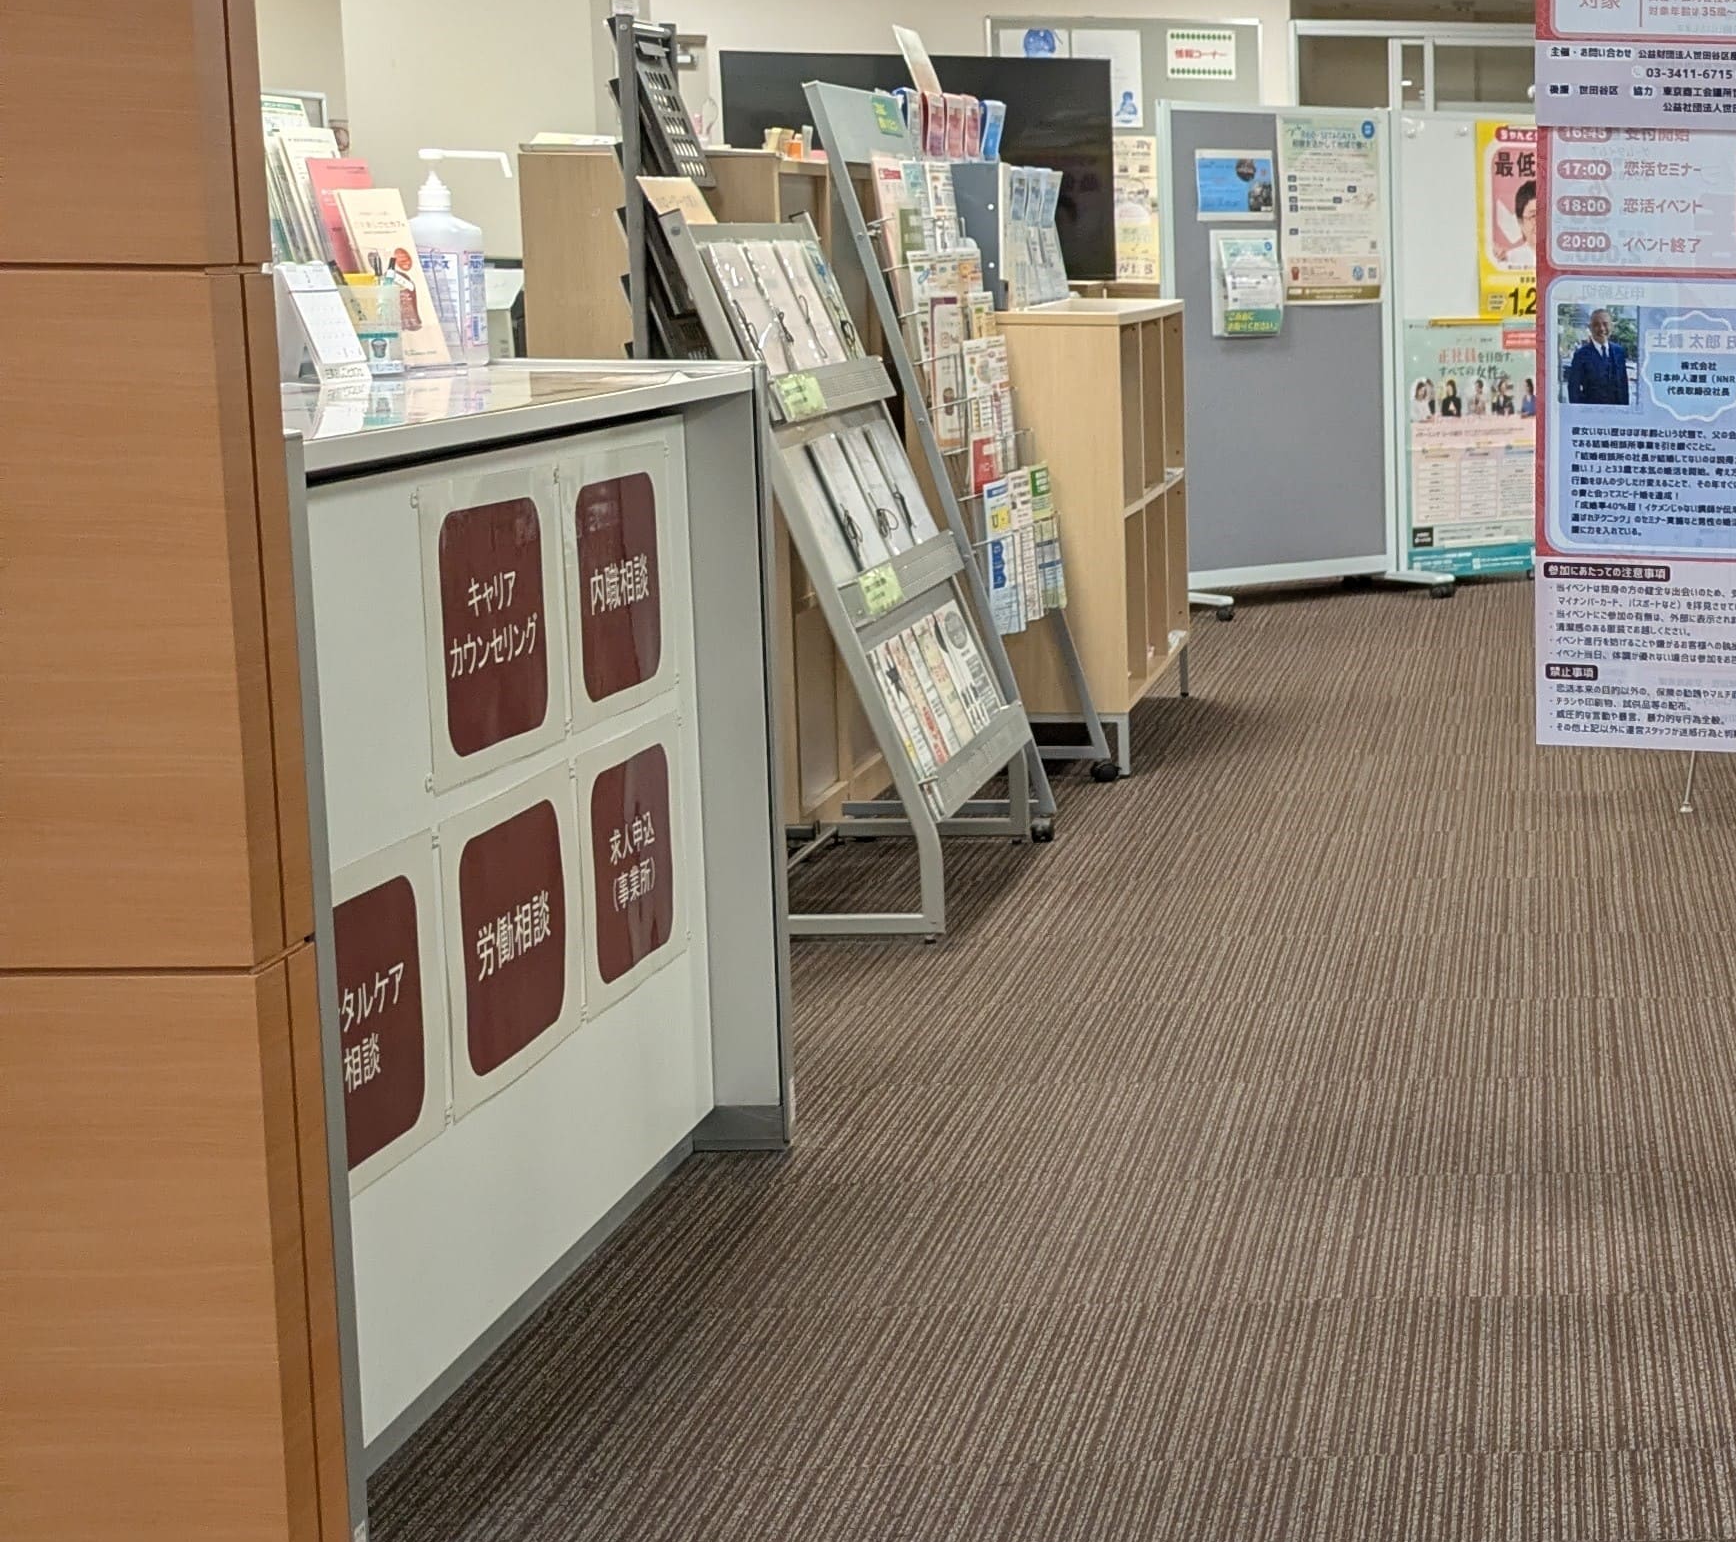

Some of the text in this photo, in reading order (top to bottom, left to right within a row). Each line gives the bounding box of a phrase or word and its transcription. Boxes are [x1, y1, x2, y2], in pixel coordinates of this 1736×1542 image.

[1551, 47, 1631, 58] 主催・お問い合わせ
[1646, 68, 1733, 79] 03-3411-6715
[1579, 85, 1618, 95] 世田谷区
[1633, 86, 1653, 96] 協力
[1495, 152, 1536, 177] 最低
[1563, 161, 1701, 177] 17:00 恋活セミナー
[1563, 198, 1703, 214] 18:00 恋活イベント
[1562, 235, 1702, 254] 20:00 イベント終了
[1681, 361, 1717, 371] 株式会社
[1667, 386, 1730, 396] 代表取締役社長
[1548, 565, 1666, 580] 参加にあたっての注意事項
[468, 571, 517, 617] キャリア
[590, 553, 651, 616] 内職相談
[450, 614, 538, 681] カウンセリング
[1550, 666, 1594, 678] 禁止事項
[609, 812, 656, 865] 求人申込
[613, 864, 656, 913] （事業所）
[476, 891, 552, 983] 労働相談
[338, 962, 404, 1033] タルケア
[344, 1032, 381, 1094] 相談
